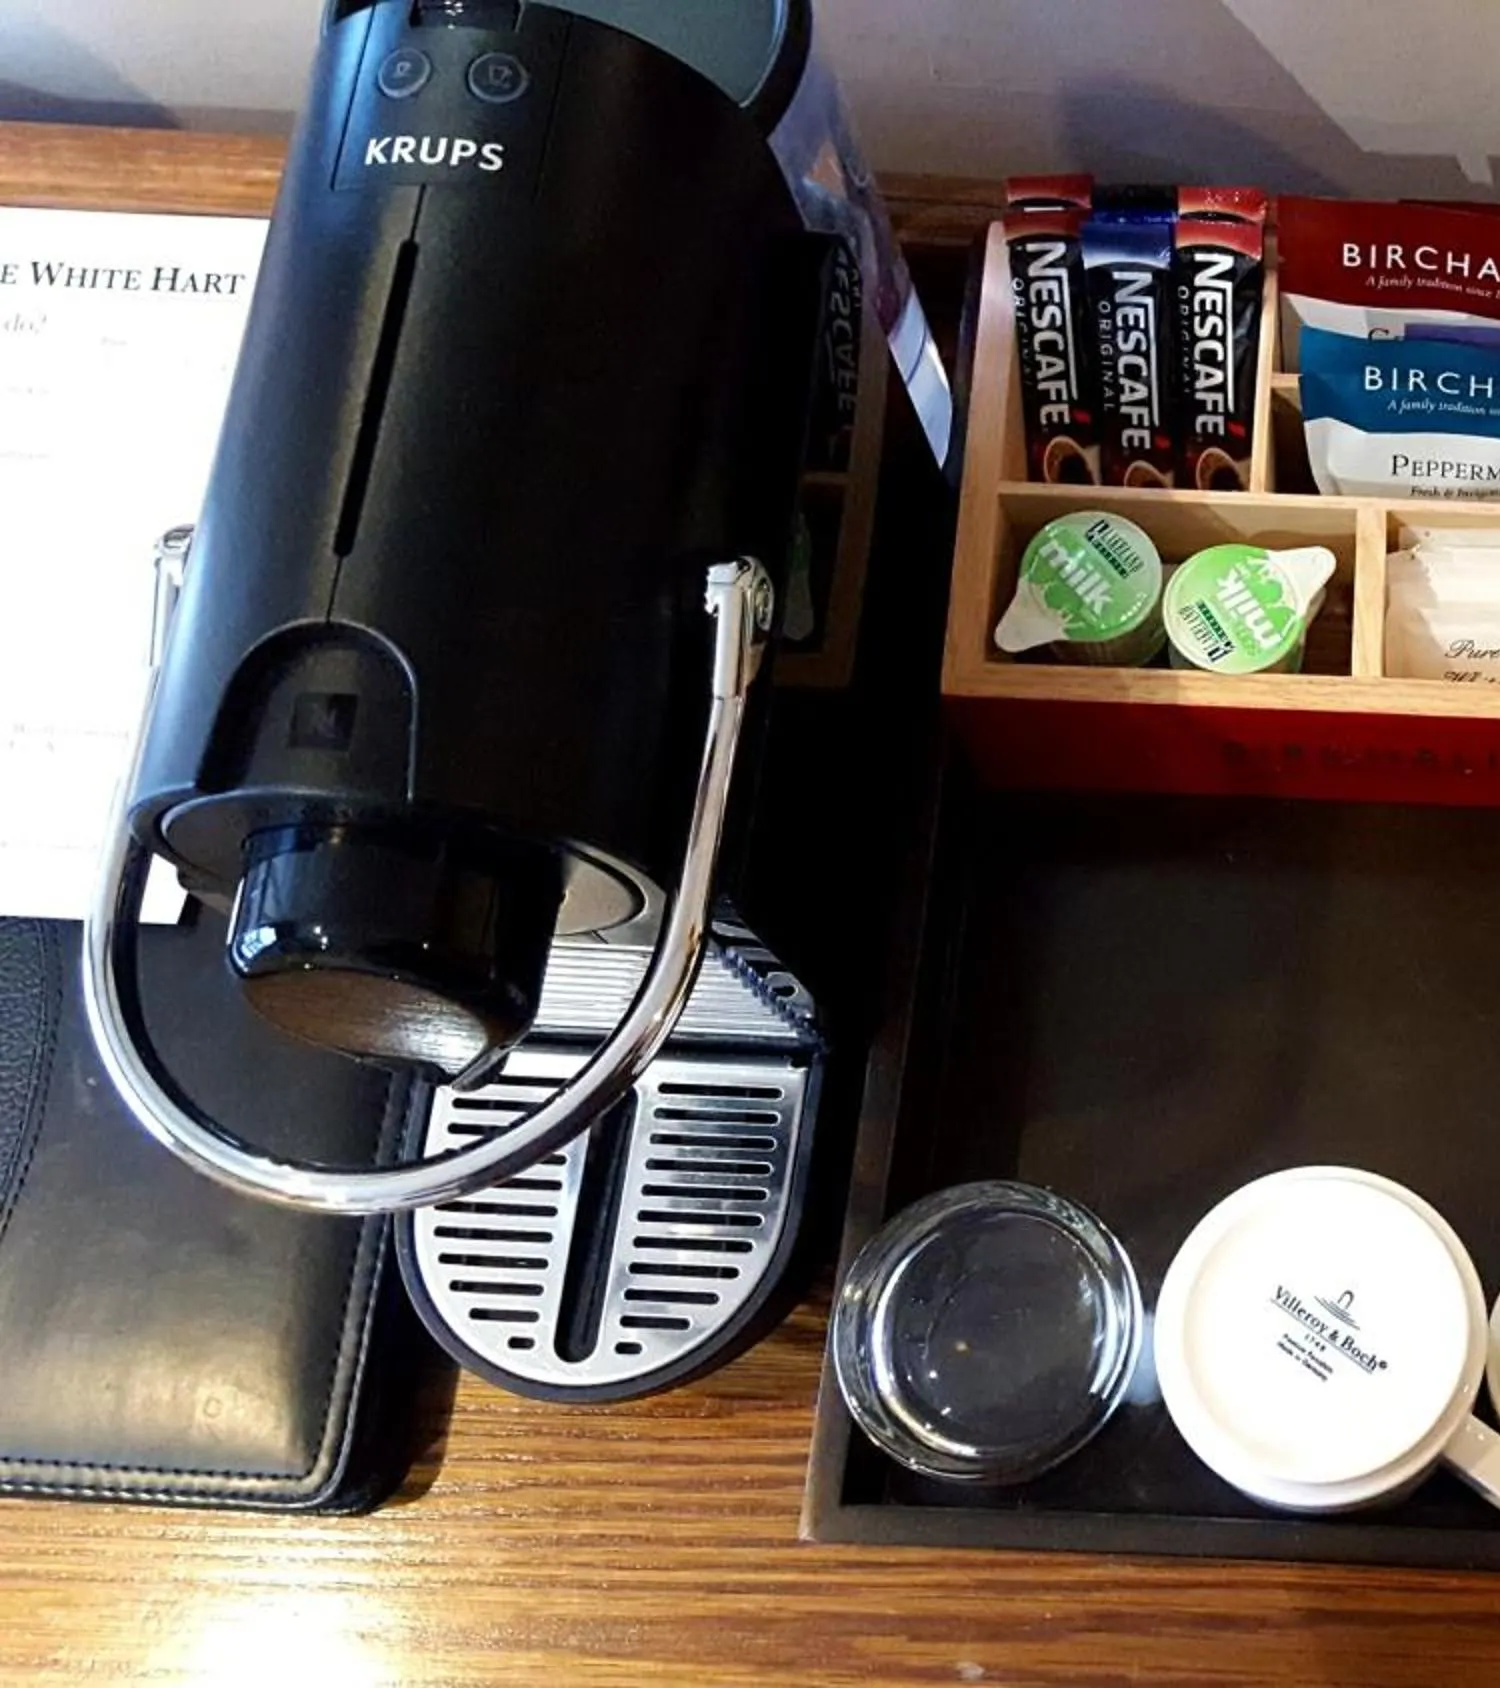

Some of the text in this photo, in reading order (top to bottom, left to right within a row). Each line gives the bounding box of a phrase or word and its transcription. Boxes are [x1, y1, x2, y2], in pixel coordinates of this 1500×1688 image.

[364, 135, 504, 171] KRUPS
[31, 261, 142, 291] WHITE
[150, 266, 246, 295] HART
[1365, 275, 1376, 287] A
[1377, 275, 1414, 290] family
[1416, 277, 1463, 292] tradition
[1465, 286, 1493, 298] since
[1098, 301, 1115, 411] ORIGINAL
[1387, 399, 1398, 411] A
[1398, 398, 1435, 415] family
[1437, 401, 1486, 415] tradition
[1410, 486, 1441, 498] Fresh
[1039, 539, 1113, 617] milk
[1215, 567, 1283, 649] milk
[1444, 639, 1500, 659] Pure
[1275, 1285, 1328, 1333] Villeroy
[1328, 1329, 1339, 1342] &
